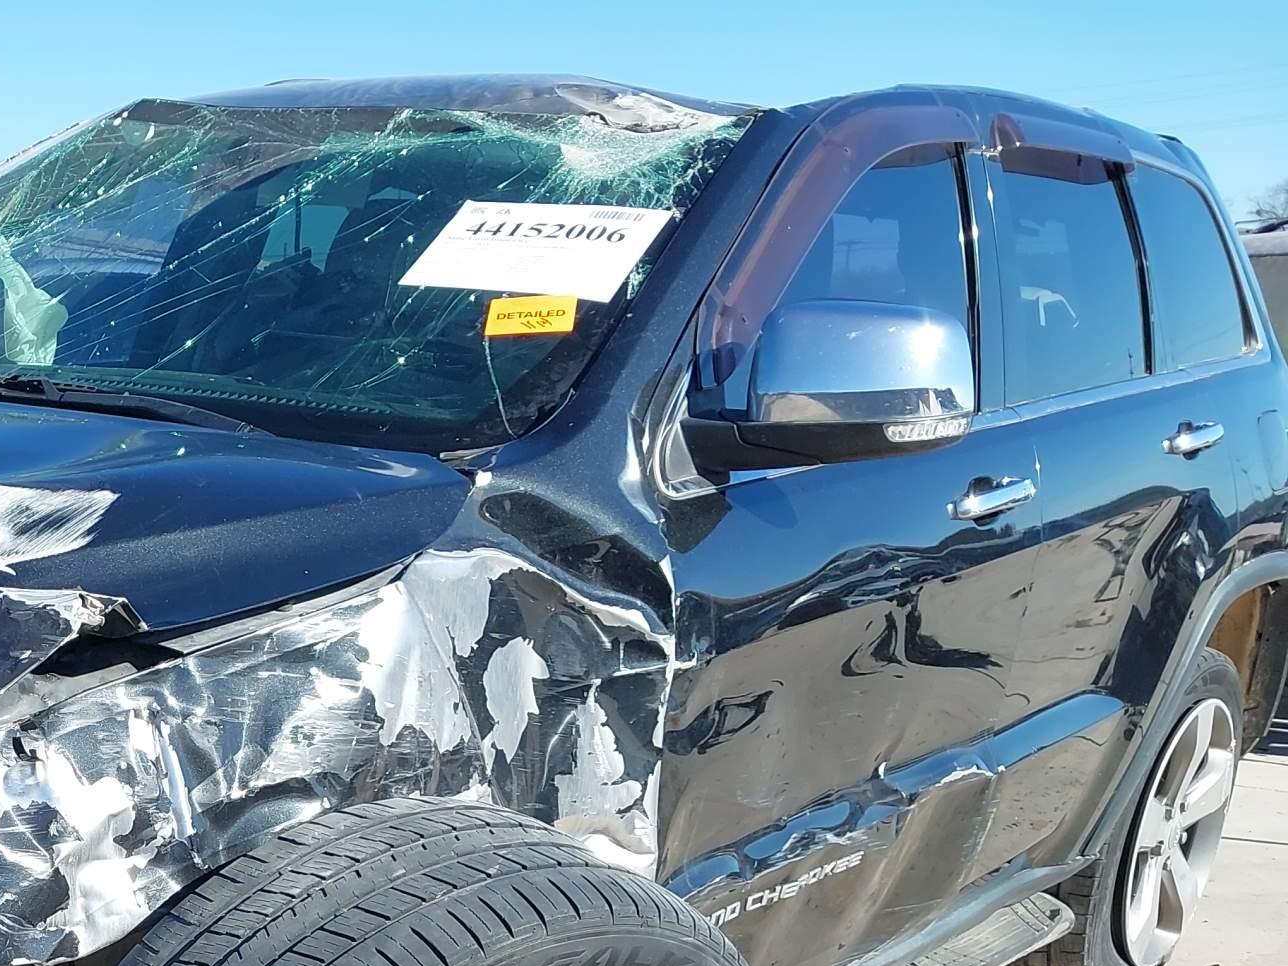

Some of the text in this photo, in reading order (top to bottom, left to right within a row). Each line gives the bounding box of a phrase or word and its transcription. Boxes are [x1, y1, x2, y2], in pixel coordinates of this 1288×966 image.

[466, 220, 631, 244] 44152006
[496, 309, 566, 321] DETAILED
[745, 850, 865, 912] CHEROKEE
